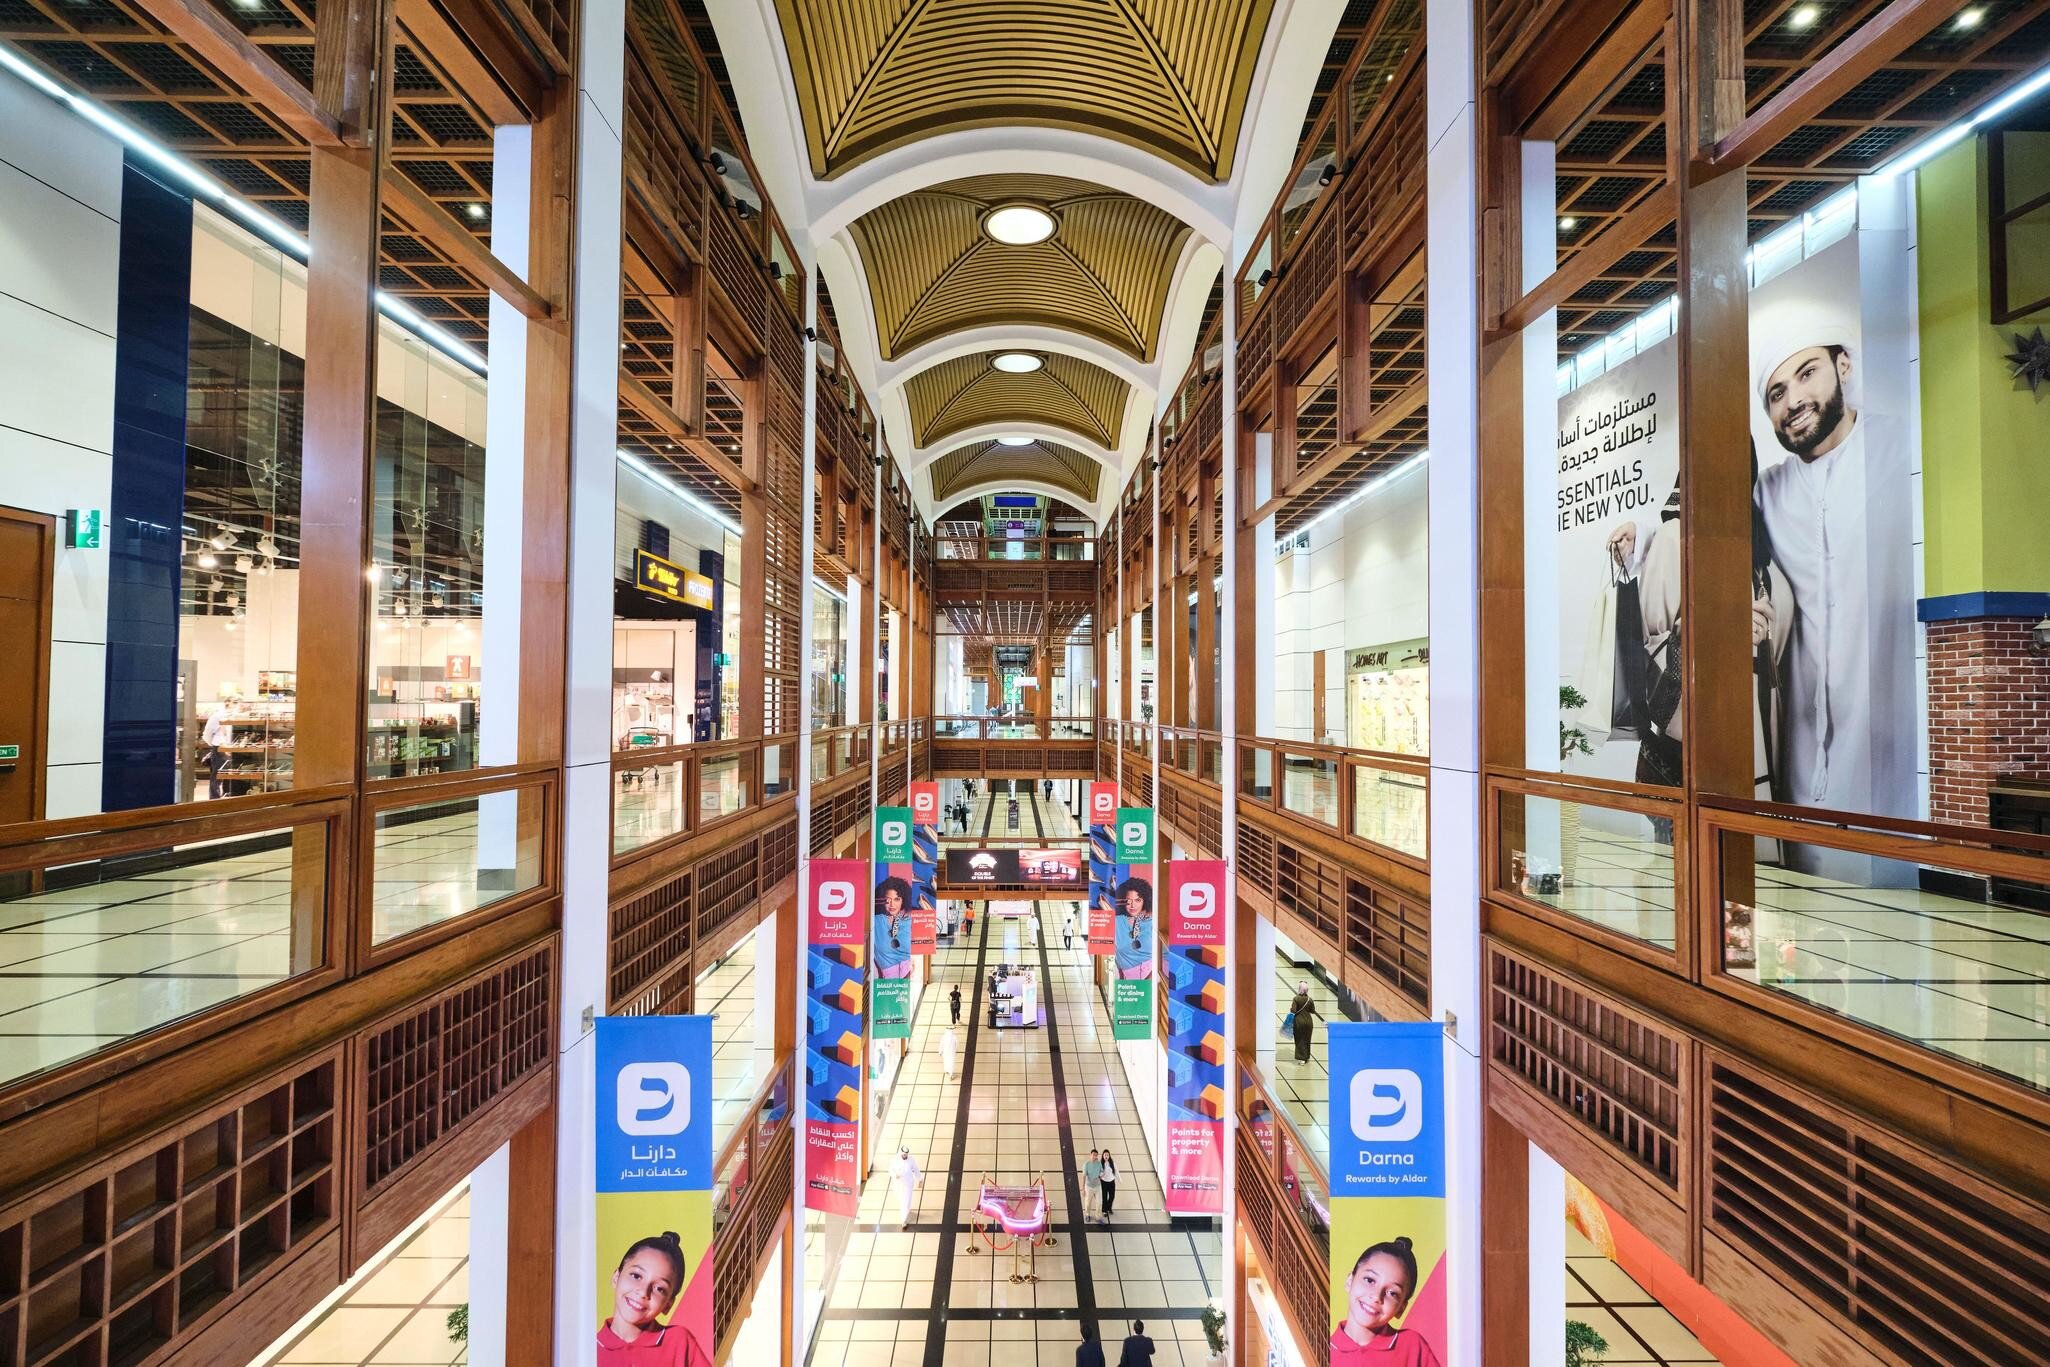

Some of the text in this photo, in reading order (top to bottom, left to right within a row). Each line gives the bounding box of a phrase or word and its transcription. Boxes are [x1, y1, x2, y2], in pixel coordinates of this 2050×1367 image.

[1584, 392, 1656, 437] مستلزمات
[1603, 413, 1657, 453] لإطلالة
[1575, 496, 1611, 527] NEW
[1615, 483, 1655, 513] YOU.
[824, 921, 848, 931] دارنا
[1183, 922, 1211, 931] Darna
[810, 1126, 831, 1137] النقاط
[1171, 1128, 1215, 1137] Points for
[1171, 1138, 1210, 1147] property
[631, 1144, 677, 1163] دارنا
[1359, 1150, 1414, 1165] Darna
[620, 1168, 644, 1180] الدار
[1345, 1174, 1428, 1185] Rewards by Aldar
